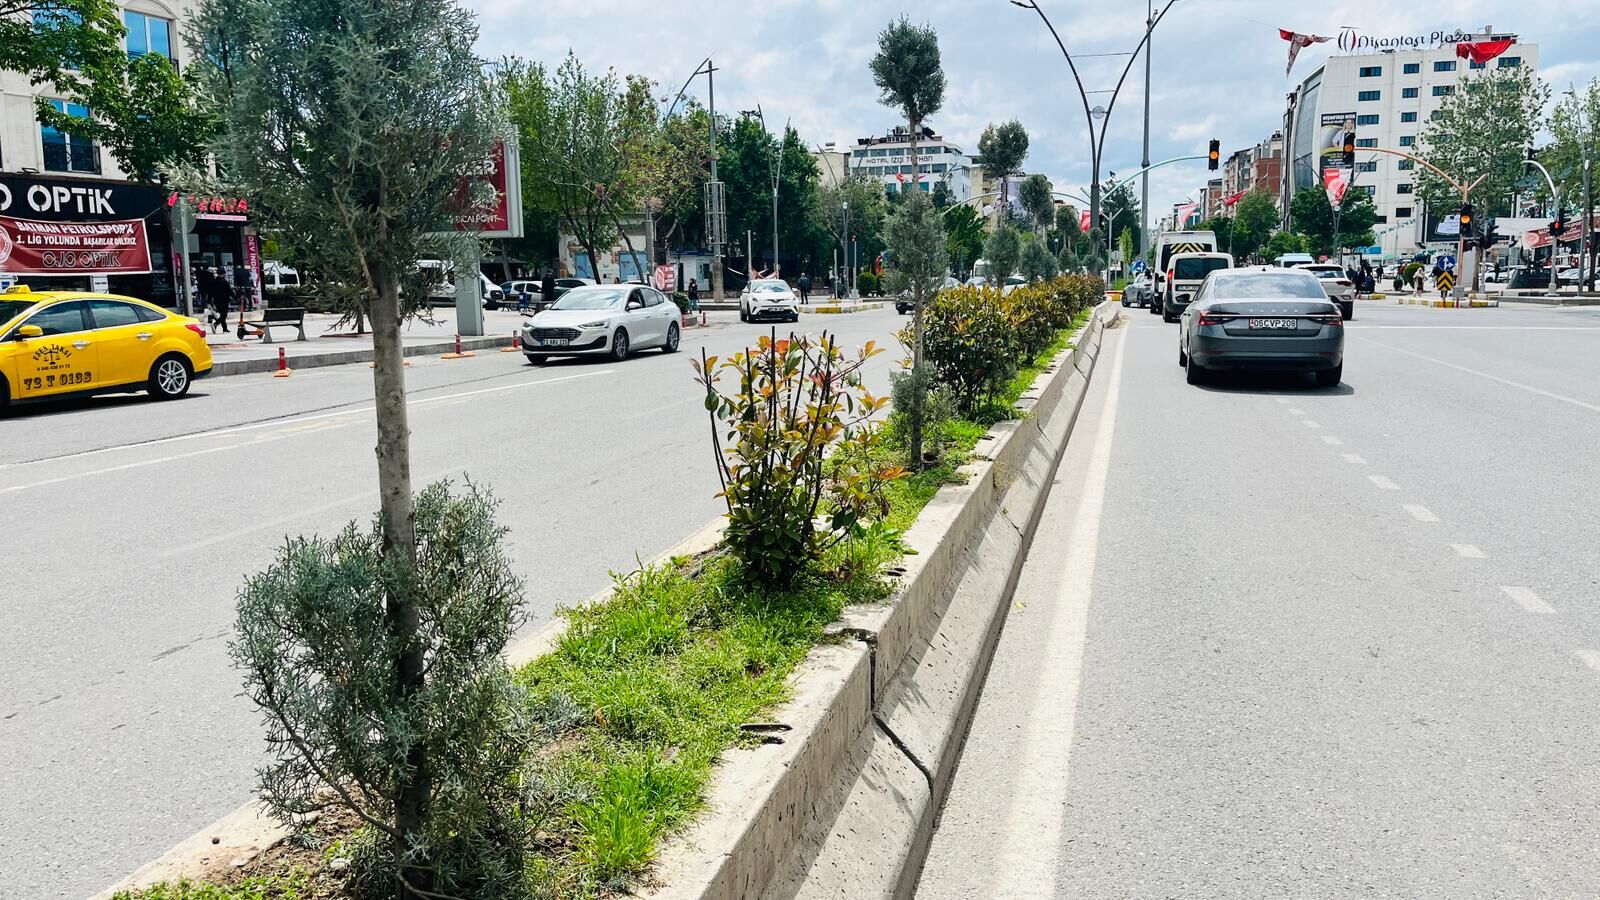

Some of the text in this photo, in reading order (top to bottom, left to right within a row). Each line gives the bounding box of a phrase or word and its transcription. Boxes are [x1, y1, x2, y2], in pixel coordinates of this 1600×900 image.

[1430, 31, 1472, 44] Plaza
[15, 221, 61, 234] BATMAN
[16, 235, 25, 244] 1.
[44, 235, 81, 246] YOLUNDA
[46, 374, 56, 387] T
